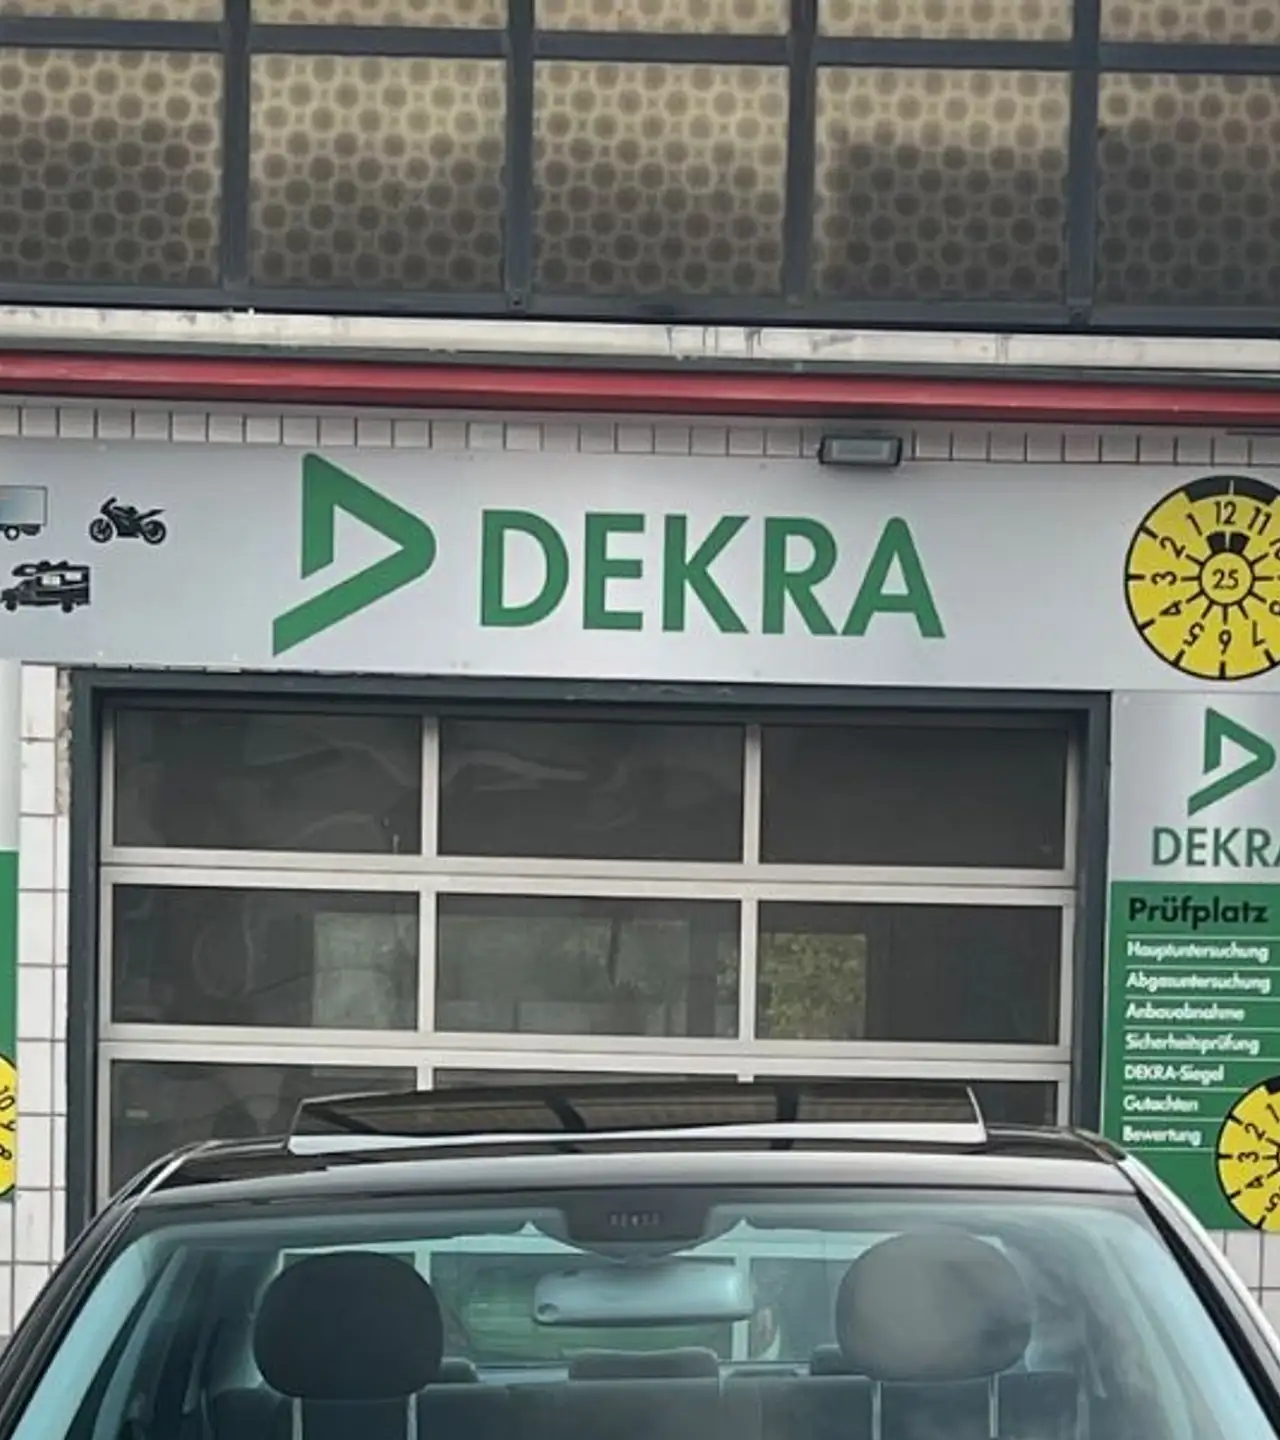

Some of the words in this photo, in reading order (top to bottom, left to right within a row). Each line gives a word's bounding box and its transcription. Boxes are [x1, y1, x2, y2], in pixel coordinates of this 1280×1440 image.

[1185, 512, 1203, 536] 1
[1214, 500, 1237, 526] 12
[1247, 506, 1273, 536] 11
[1159, 536, 1186, 558] 2
[480, 509, 946, 638] DEKRA
[1151, 570, 1178, 586] 3
[1212, 569, 1239, 590] 25
[1159, 600, 1183, 617] 4
[1183, 622, 1205, 647] 5
[1218, 630, 1232, 655] 6
[1252, 620, 1267, 647] 7
[1128, 896, 1269, 930] Prüfplatz
[1127, 941, 1270, 964] Hauptuntersuchung
[1125, 971, 1271, 994] Abgasuntersuchung
[1124, 1033, 1261, 1055] Sicherheitsprüfung
[1124, 1064, 1225, 1086] DEKRA-Siegel
[1123, 1095, 1199, 1113] Gutachten
[1266, 1103, 1280, 1123] 1
[1122, 1126, 1202, 1146] Bewertung
[1244, 1122, 1267, 1142] 2
[1237, 1151, 1259, 1163] 3
[1245, 1175, 1264, 1189] 4
